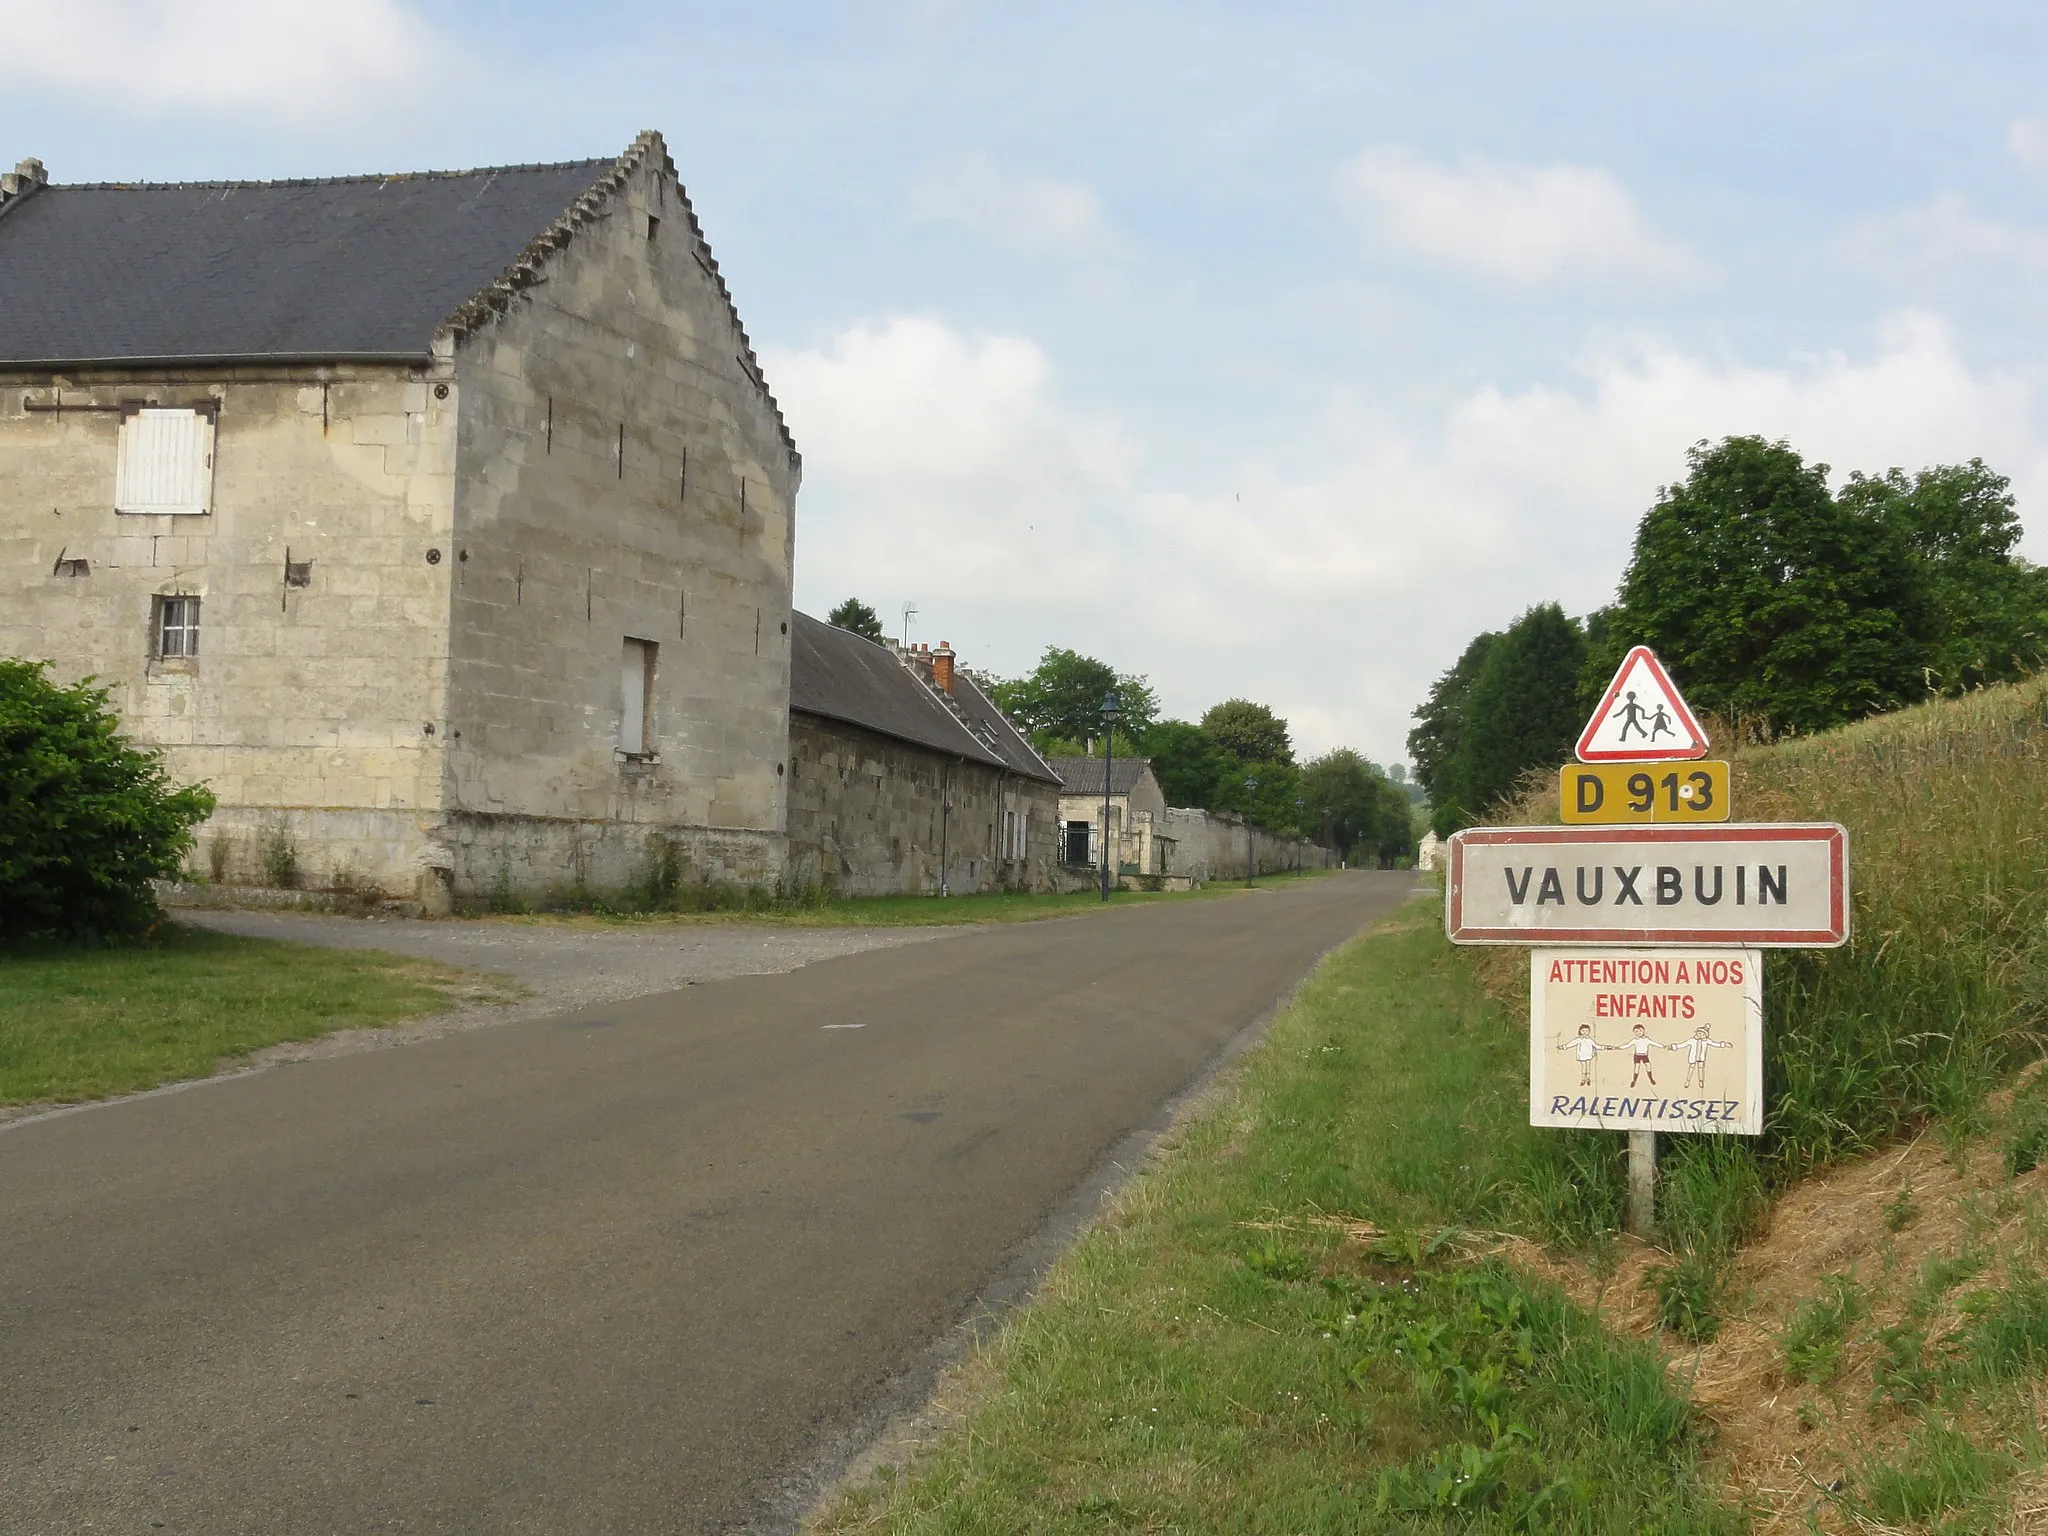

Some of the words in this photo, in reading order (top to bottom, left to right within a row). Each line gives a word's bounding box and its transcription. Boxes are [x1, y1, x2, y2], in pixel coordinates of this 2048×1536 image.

[1577, 775, 1604, 813] D
[1627, 771, 1713, 812] 913
[1504, 865, 1787, 905] VAUXBUIN
[1549, 960, 1668, 984] ATTENTION
[1675, 961, 1690, 984] A
[1697, 961, 1743, 985] NOS
[1596, 994, 1695, 1019] ENFANTS
[1551, 1095, 1739, 1121] RALENTISSEZ
